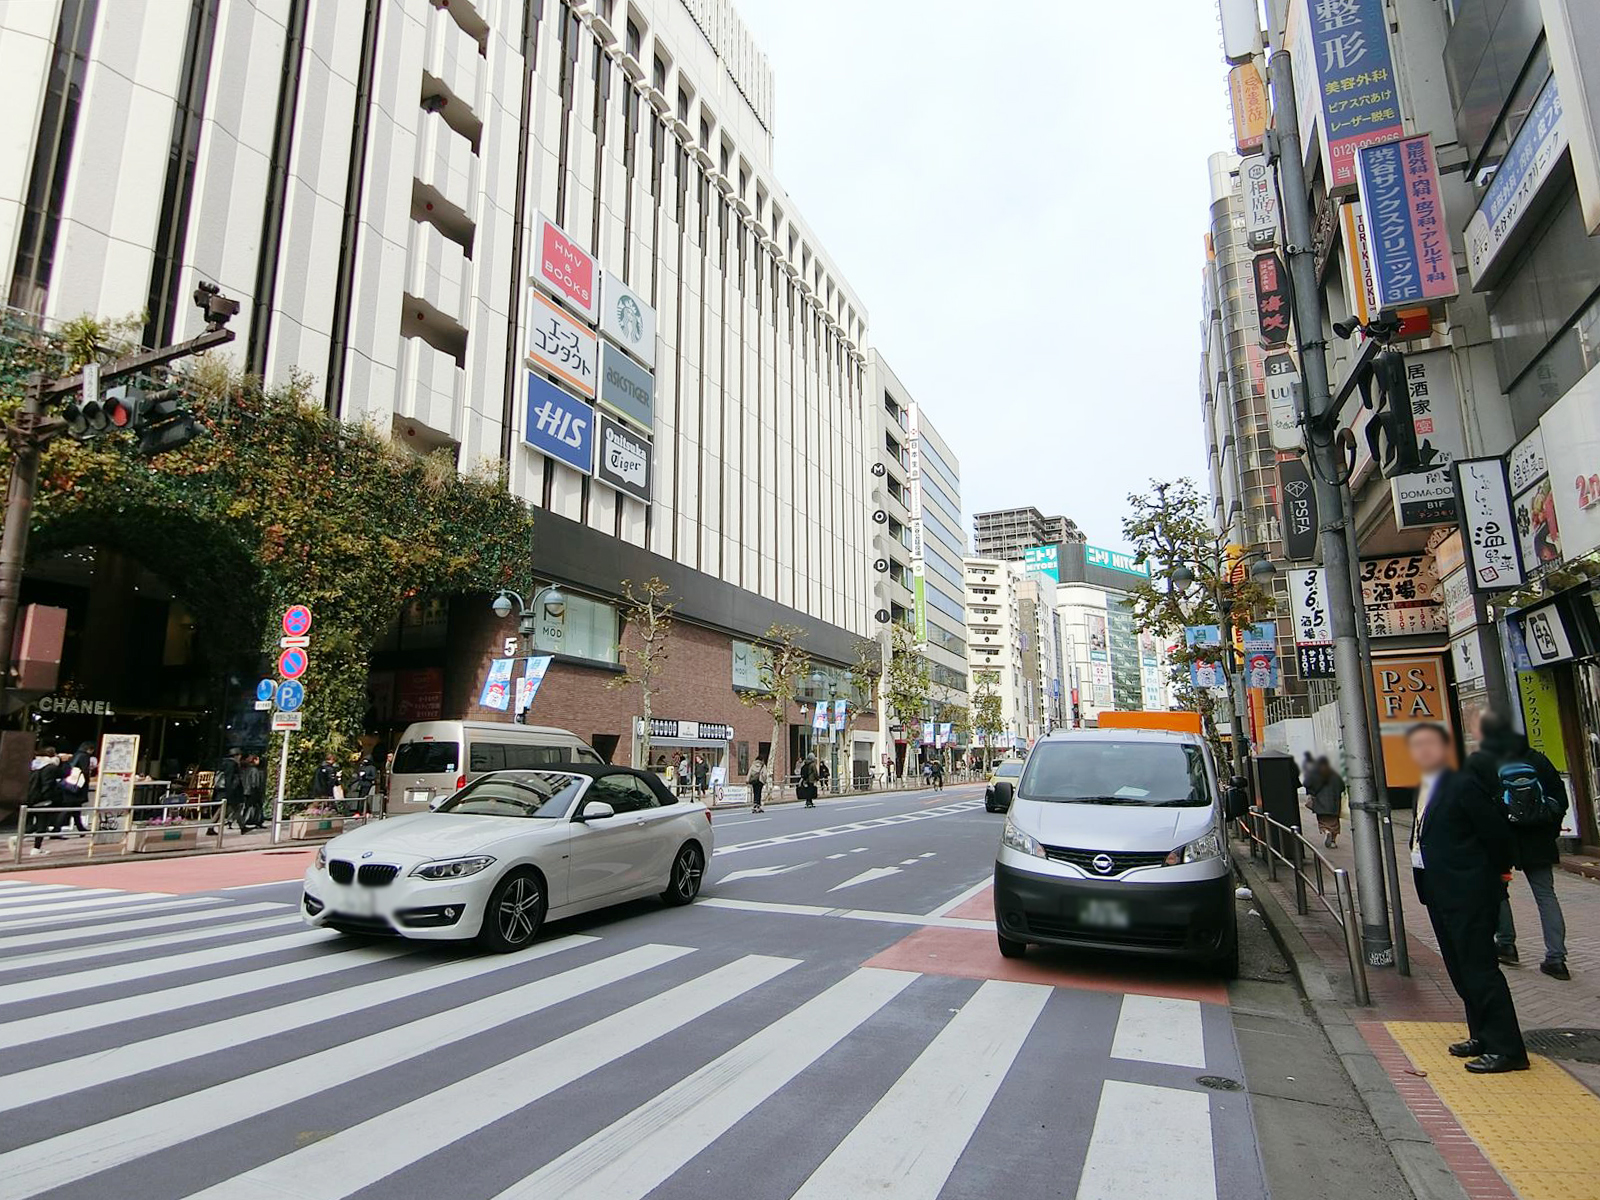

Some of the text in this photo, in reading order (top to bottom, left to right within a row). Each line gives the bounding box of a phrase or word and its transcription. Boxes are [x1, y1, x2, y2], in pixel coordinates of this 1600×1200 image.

[1317, 0, 1368, 73] 整形
[1325, 69, 1388, 95] 美容外科
[1328, 89, 1392, 113] ピアス穴あけ
[1331, 108, 1395, 132] レーザー脱毛
[1368, 148, 1412, 286] 渋谷サンクスクリニック
[1255, 229, 1274, 241] 5F
[554, 241, 583, 268] HMV
[1356, 214, 1376, 306] TORIKIZOKU
[545, 261, 590, 300] BOOKS
[564, 264, 572, 273] &
[1389, 286, 1418, 300] 3F
[550, 318, 580, 353] エース
[535, 328, 591, 377] コンタクト
[1270, 361, 1290, 375] 3F
[1408, 363, 1431, 415] 居酒家
[605, 427, 647, 459] Onitsuka
[611, 450, 642, 472] Tiger
[1400, 487, 1455, 500] DOMA-DO
[1296, 499, 1311, 535] PSFA
[1025, 547, 1057, 562] ニトリ
[1088, 548, 1109, 567] ニトリ
[1026, 562, 1058, 572] NITORI
[1373, 579, 1416, 602] 酒場
[1300, 615, 1316, 639] 酒場
[1380, 668, 1435, 693] P.S.
[39, 696, 115, 716] CHANEL
[281, 687, 293, 707] P
